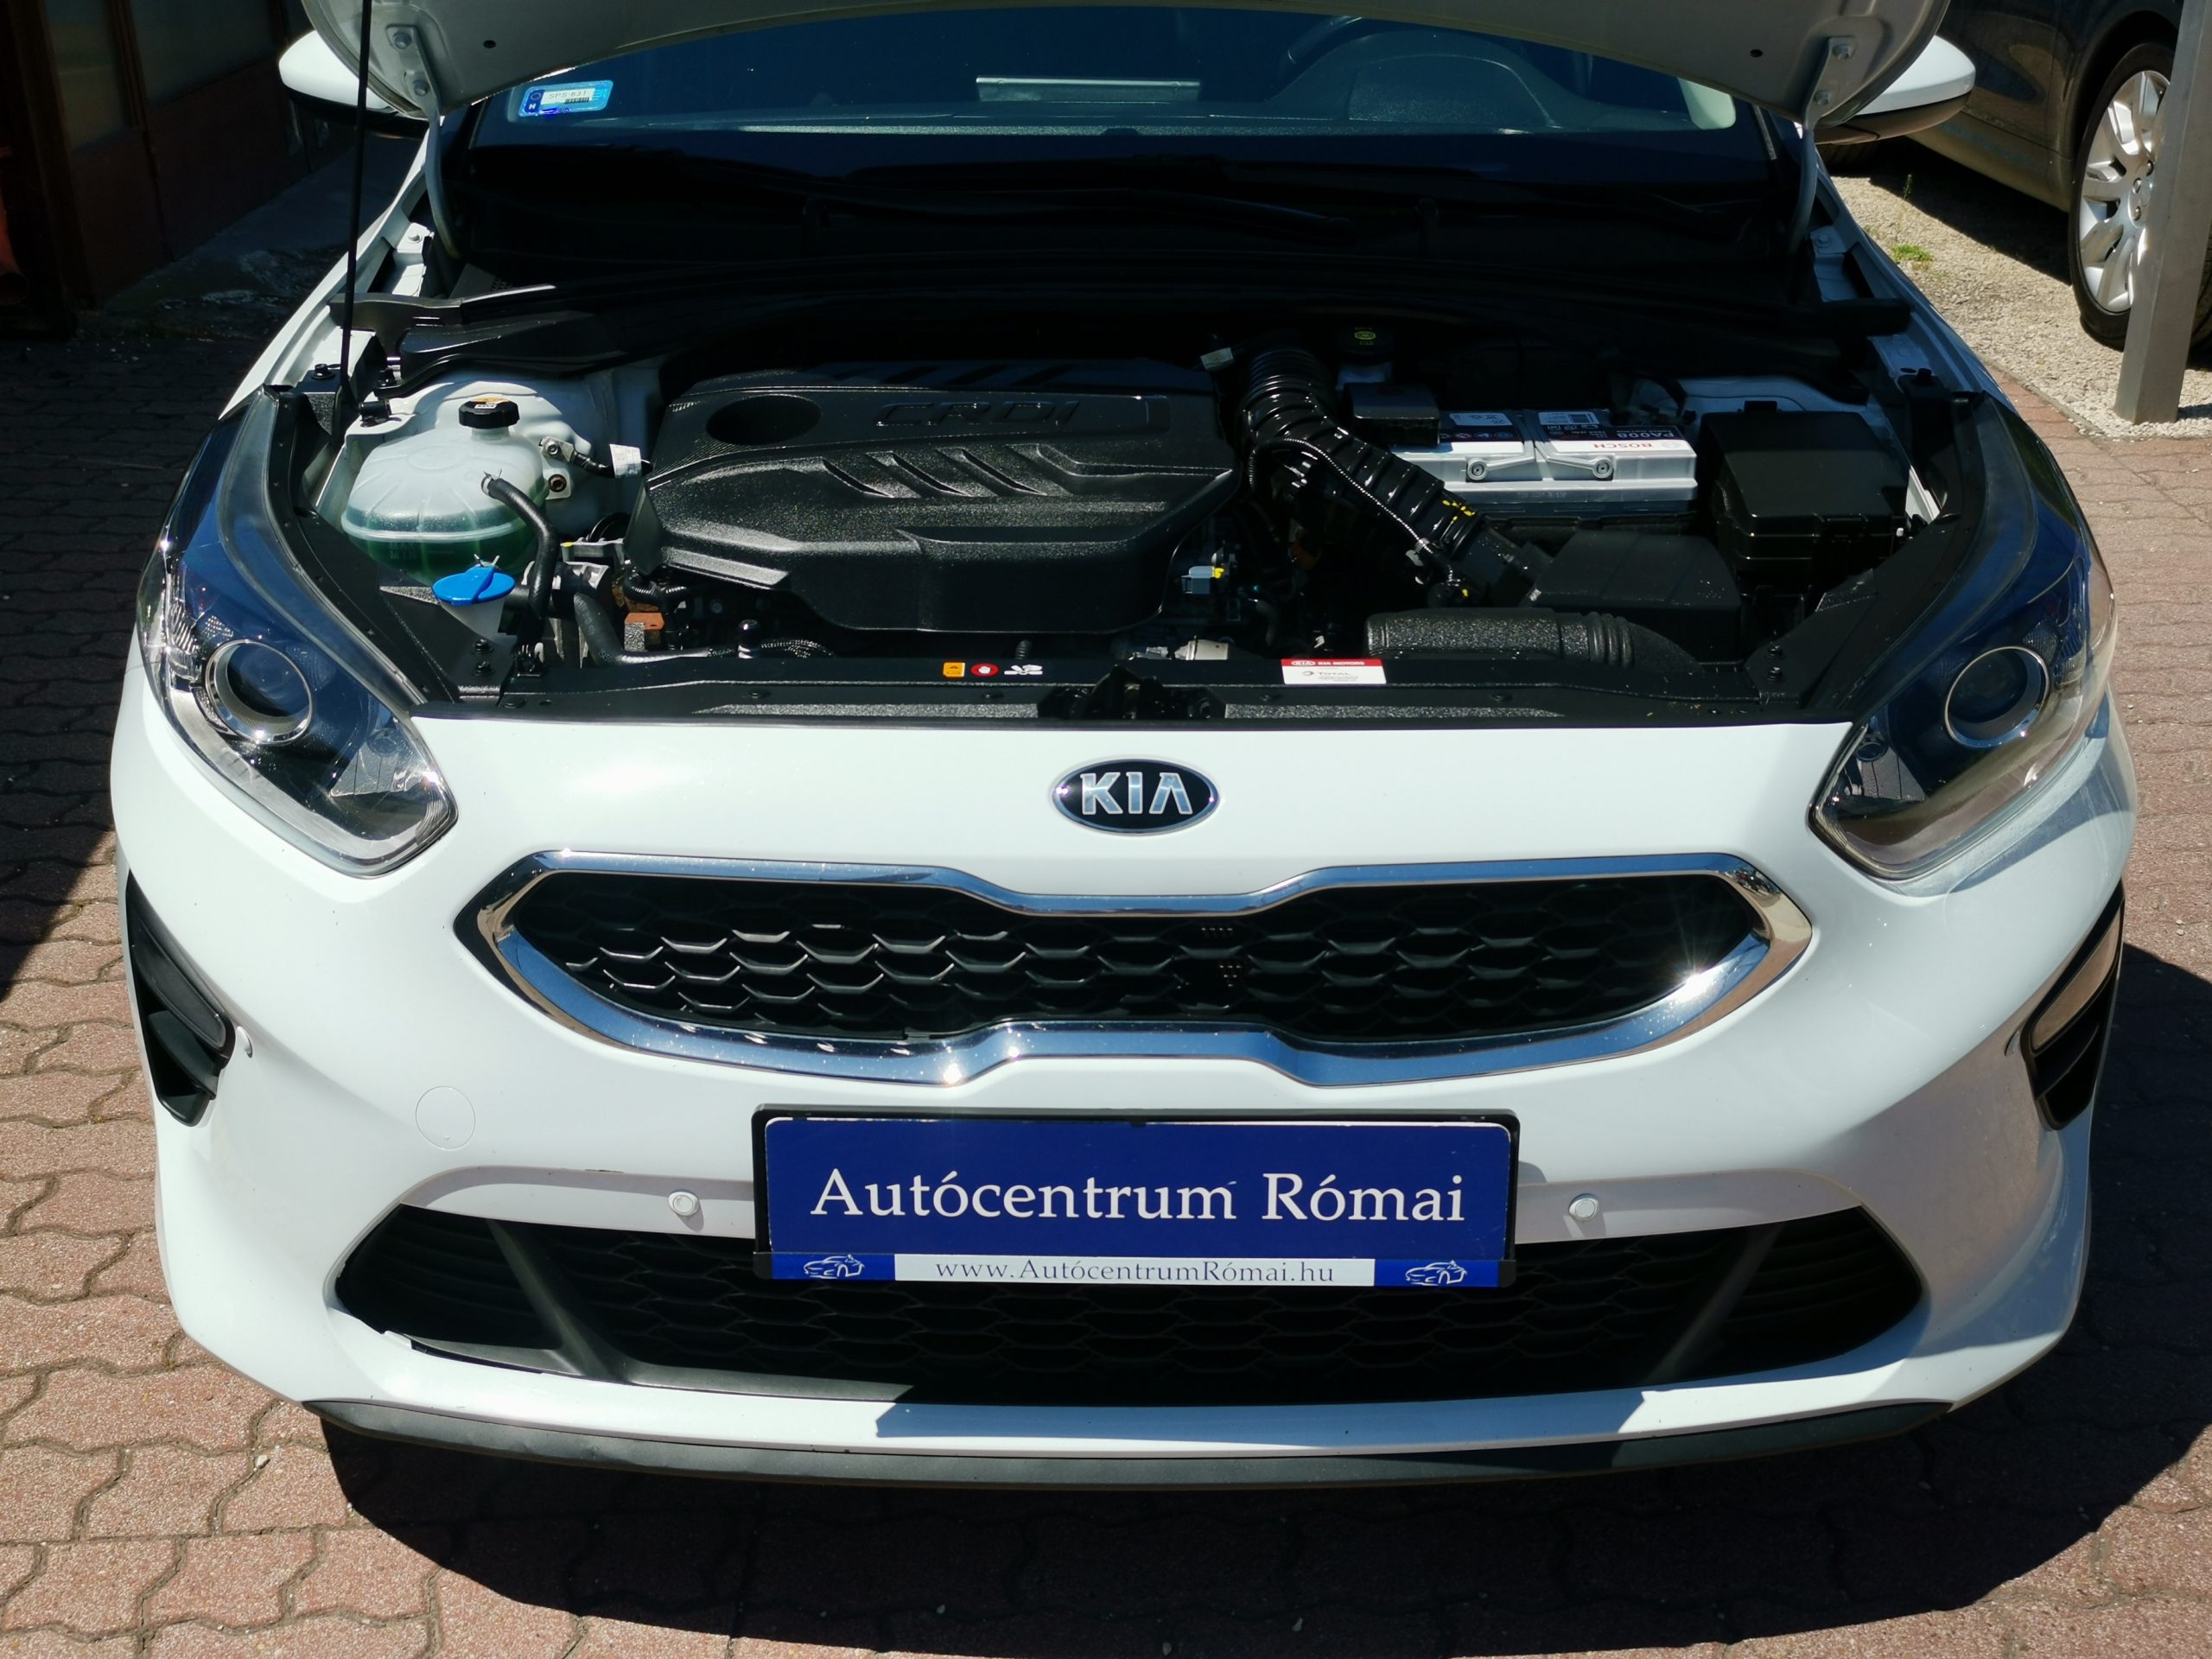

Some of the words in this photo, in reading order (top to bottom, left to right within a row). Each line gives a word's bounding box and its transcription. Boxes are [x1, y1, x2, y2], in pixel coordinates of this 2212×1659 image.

[1080, 772, 1193, 815] KIA
[810, 1168, 1236, 1219] Autócentrum
[1262, 1173, 1465, 1221] Római
[935, 1259, 1334, 1282] www.AutócentrumRómai.hu
